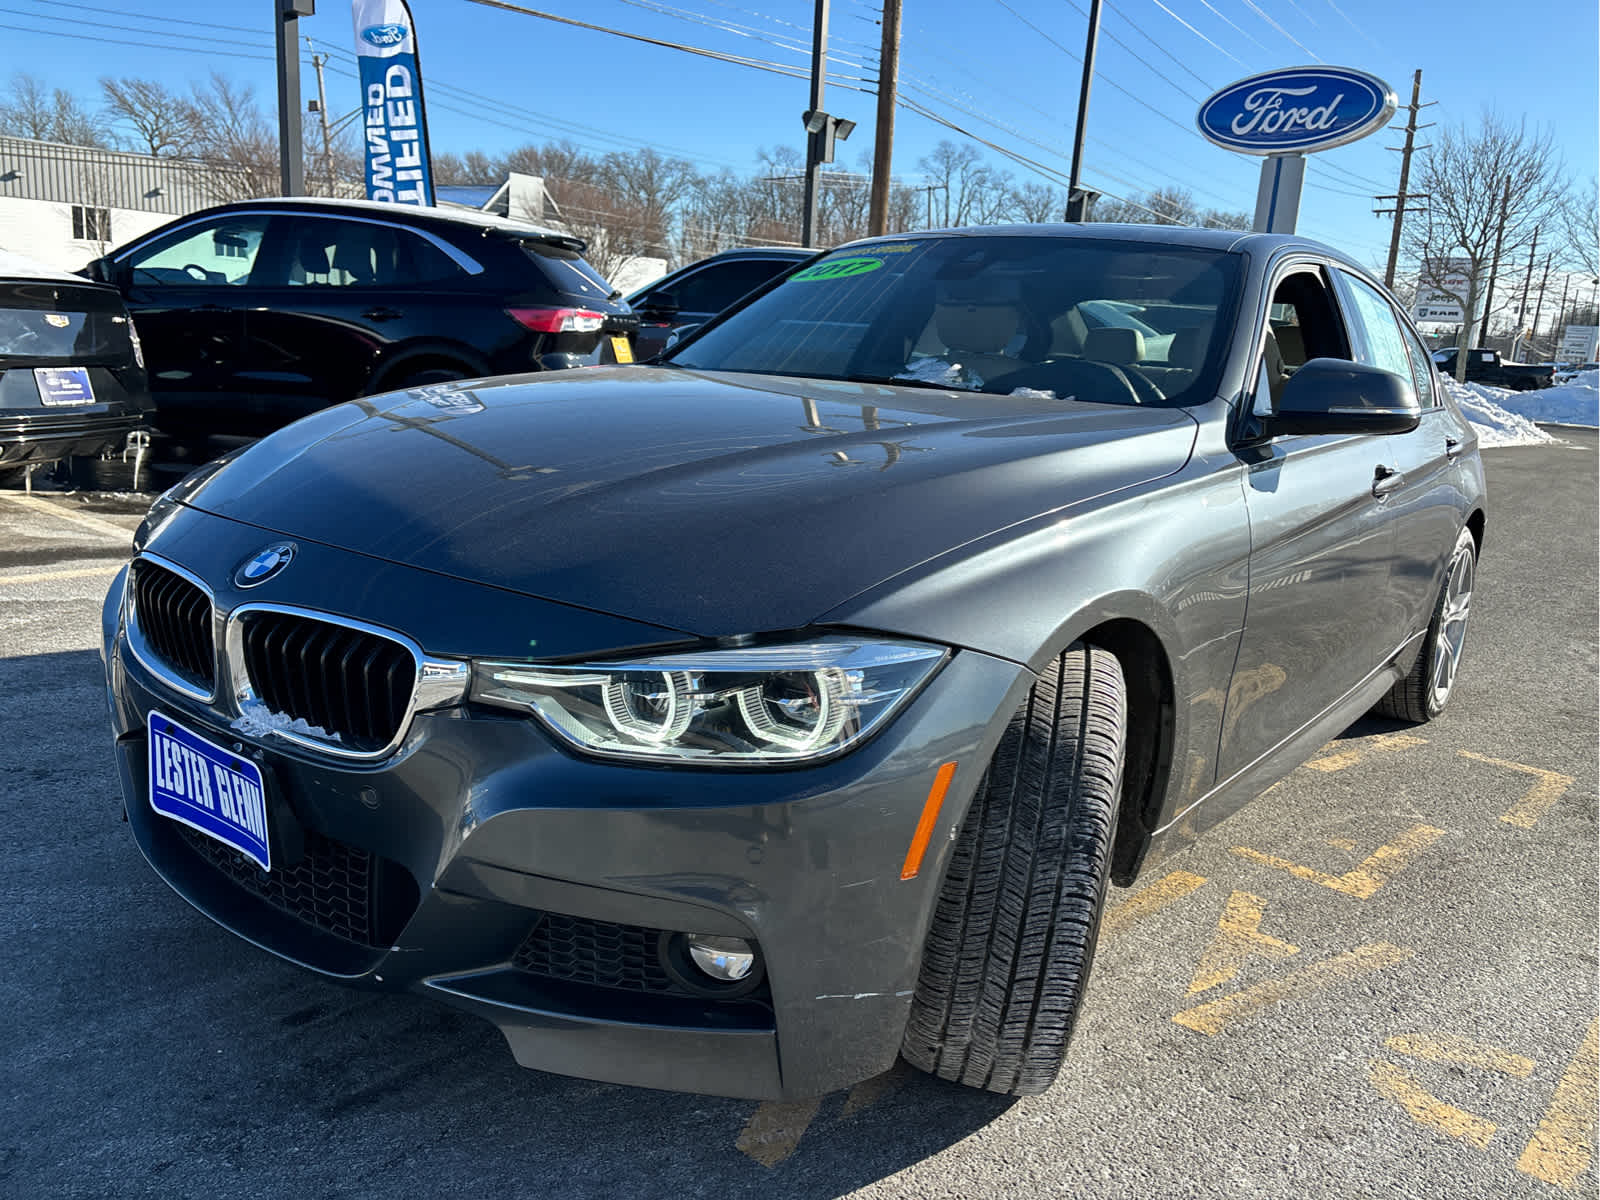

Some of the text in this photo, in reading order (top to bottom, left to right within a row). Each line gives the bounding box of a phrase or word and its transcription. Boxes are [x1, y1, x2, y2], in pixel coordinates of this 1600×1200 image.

[1231, 85, 1345, 136] Ford
[796, 260, 877, 280] 2017
[1426, 291, 1456, 304] Jeep
[154, 733, 265, 843] LESTER GLENN
